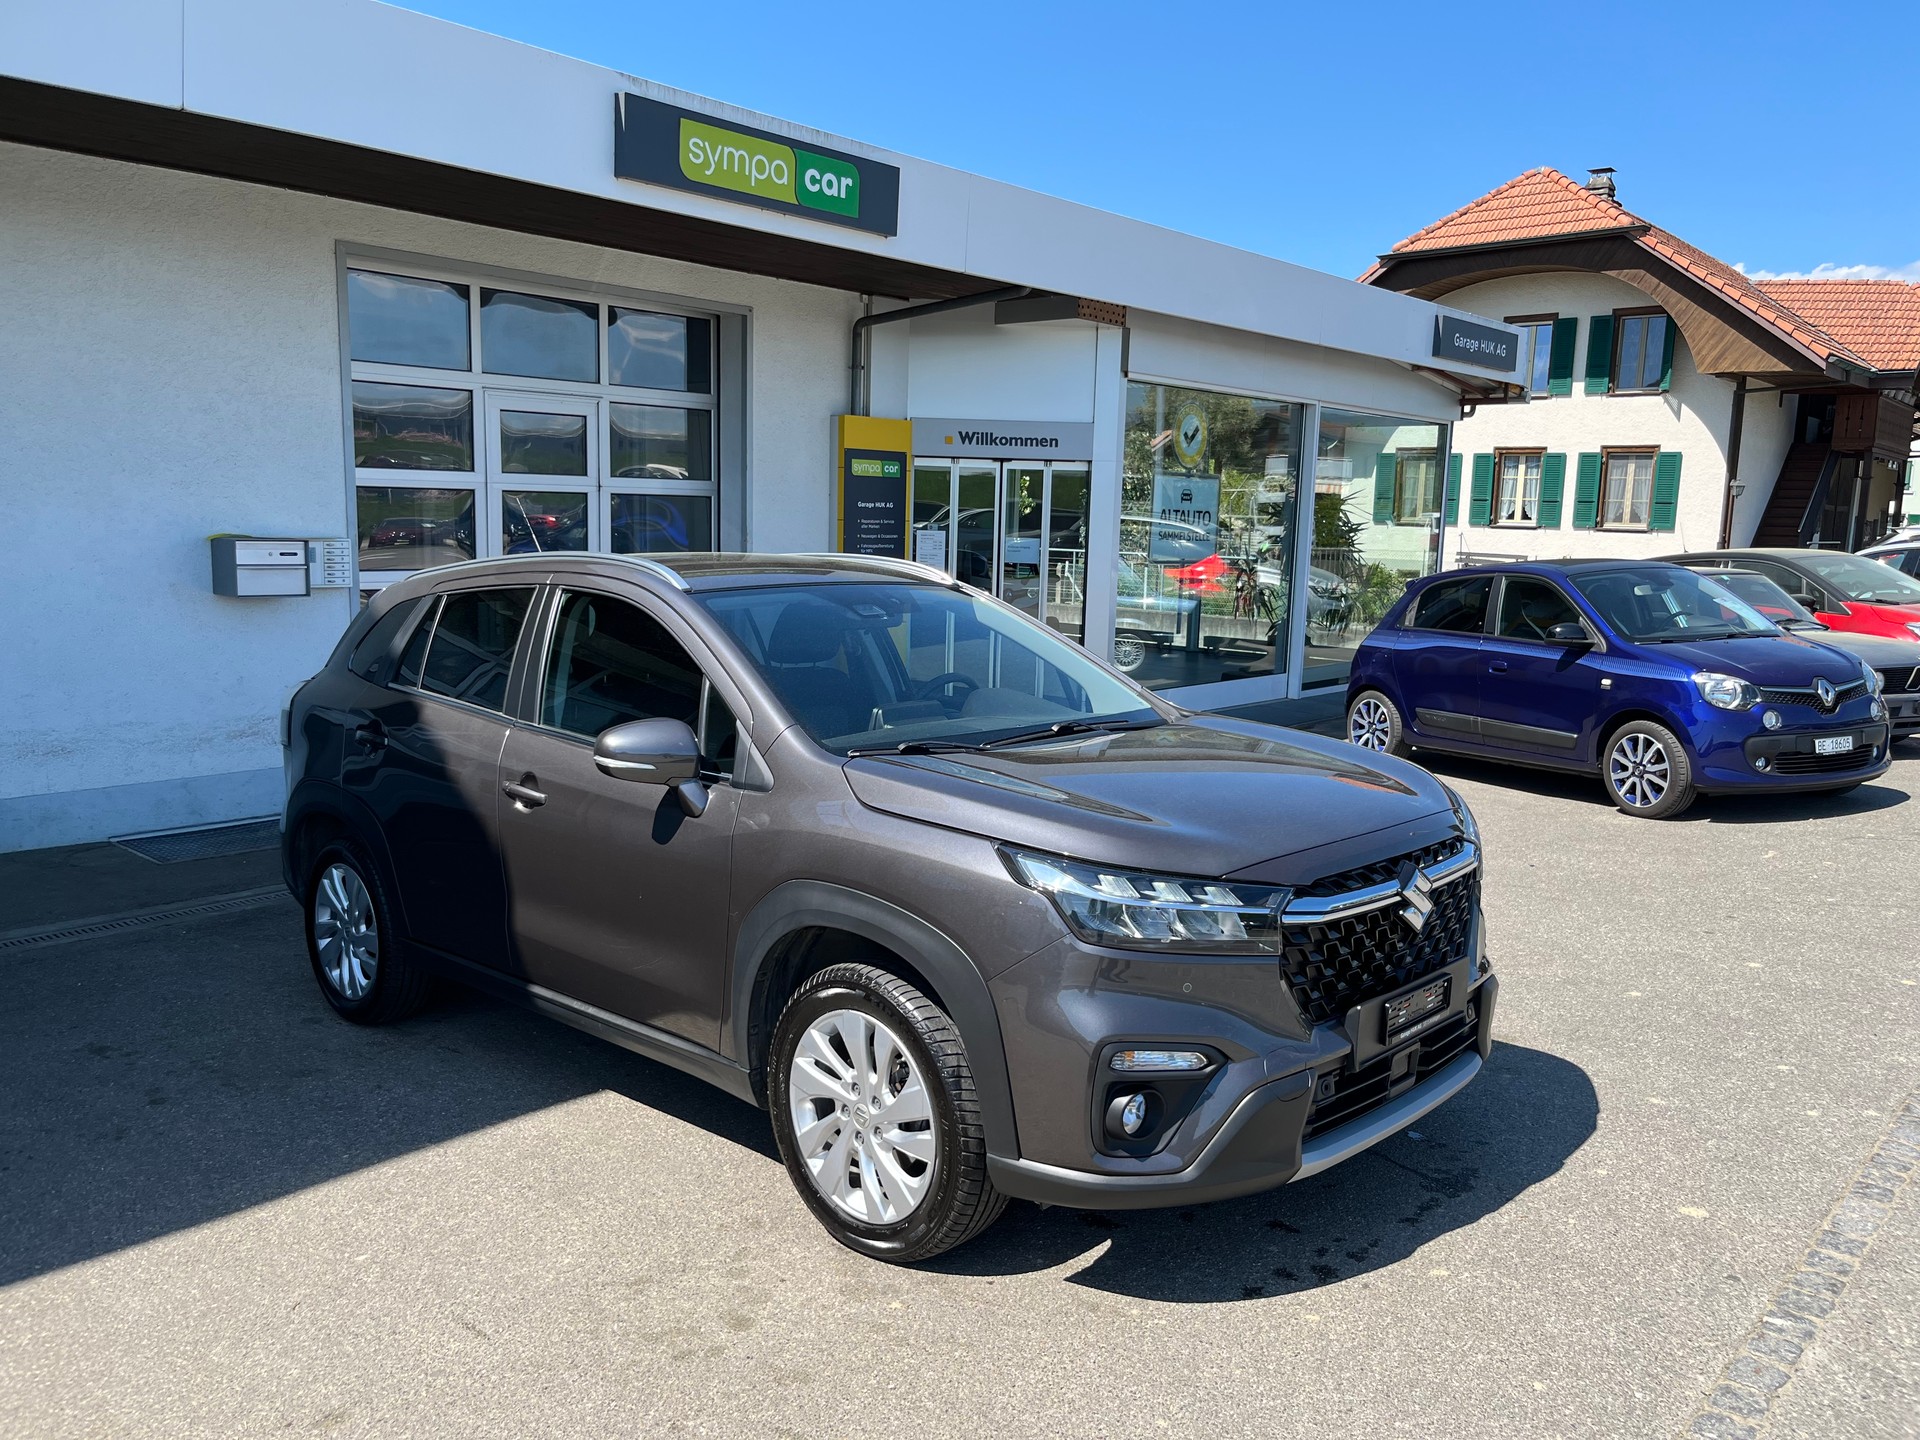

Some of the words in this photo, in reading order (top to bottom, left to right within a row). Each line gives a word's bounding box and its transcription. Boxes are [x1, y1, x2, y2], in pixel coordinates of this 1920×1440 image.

[689, 137, 788, 186] sympa
[804, 168, 853, 199] car
[1454, 333, 1478, 352] Garage
[1480, 340, 1495, 354] HUK
[1496, 344, 1506, 357] AG
[958, 430, 1058, 448] Willkommen
[854, 464, 880, 474] sympa
[1818, 740, 1826, 751] BE
[1831, 738, 1850, 750] 18605
